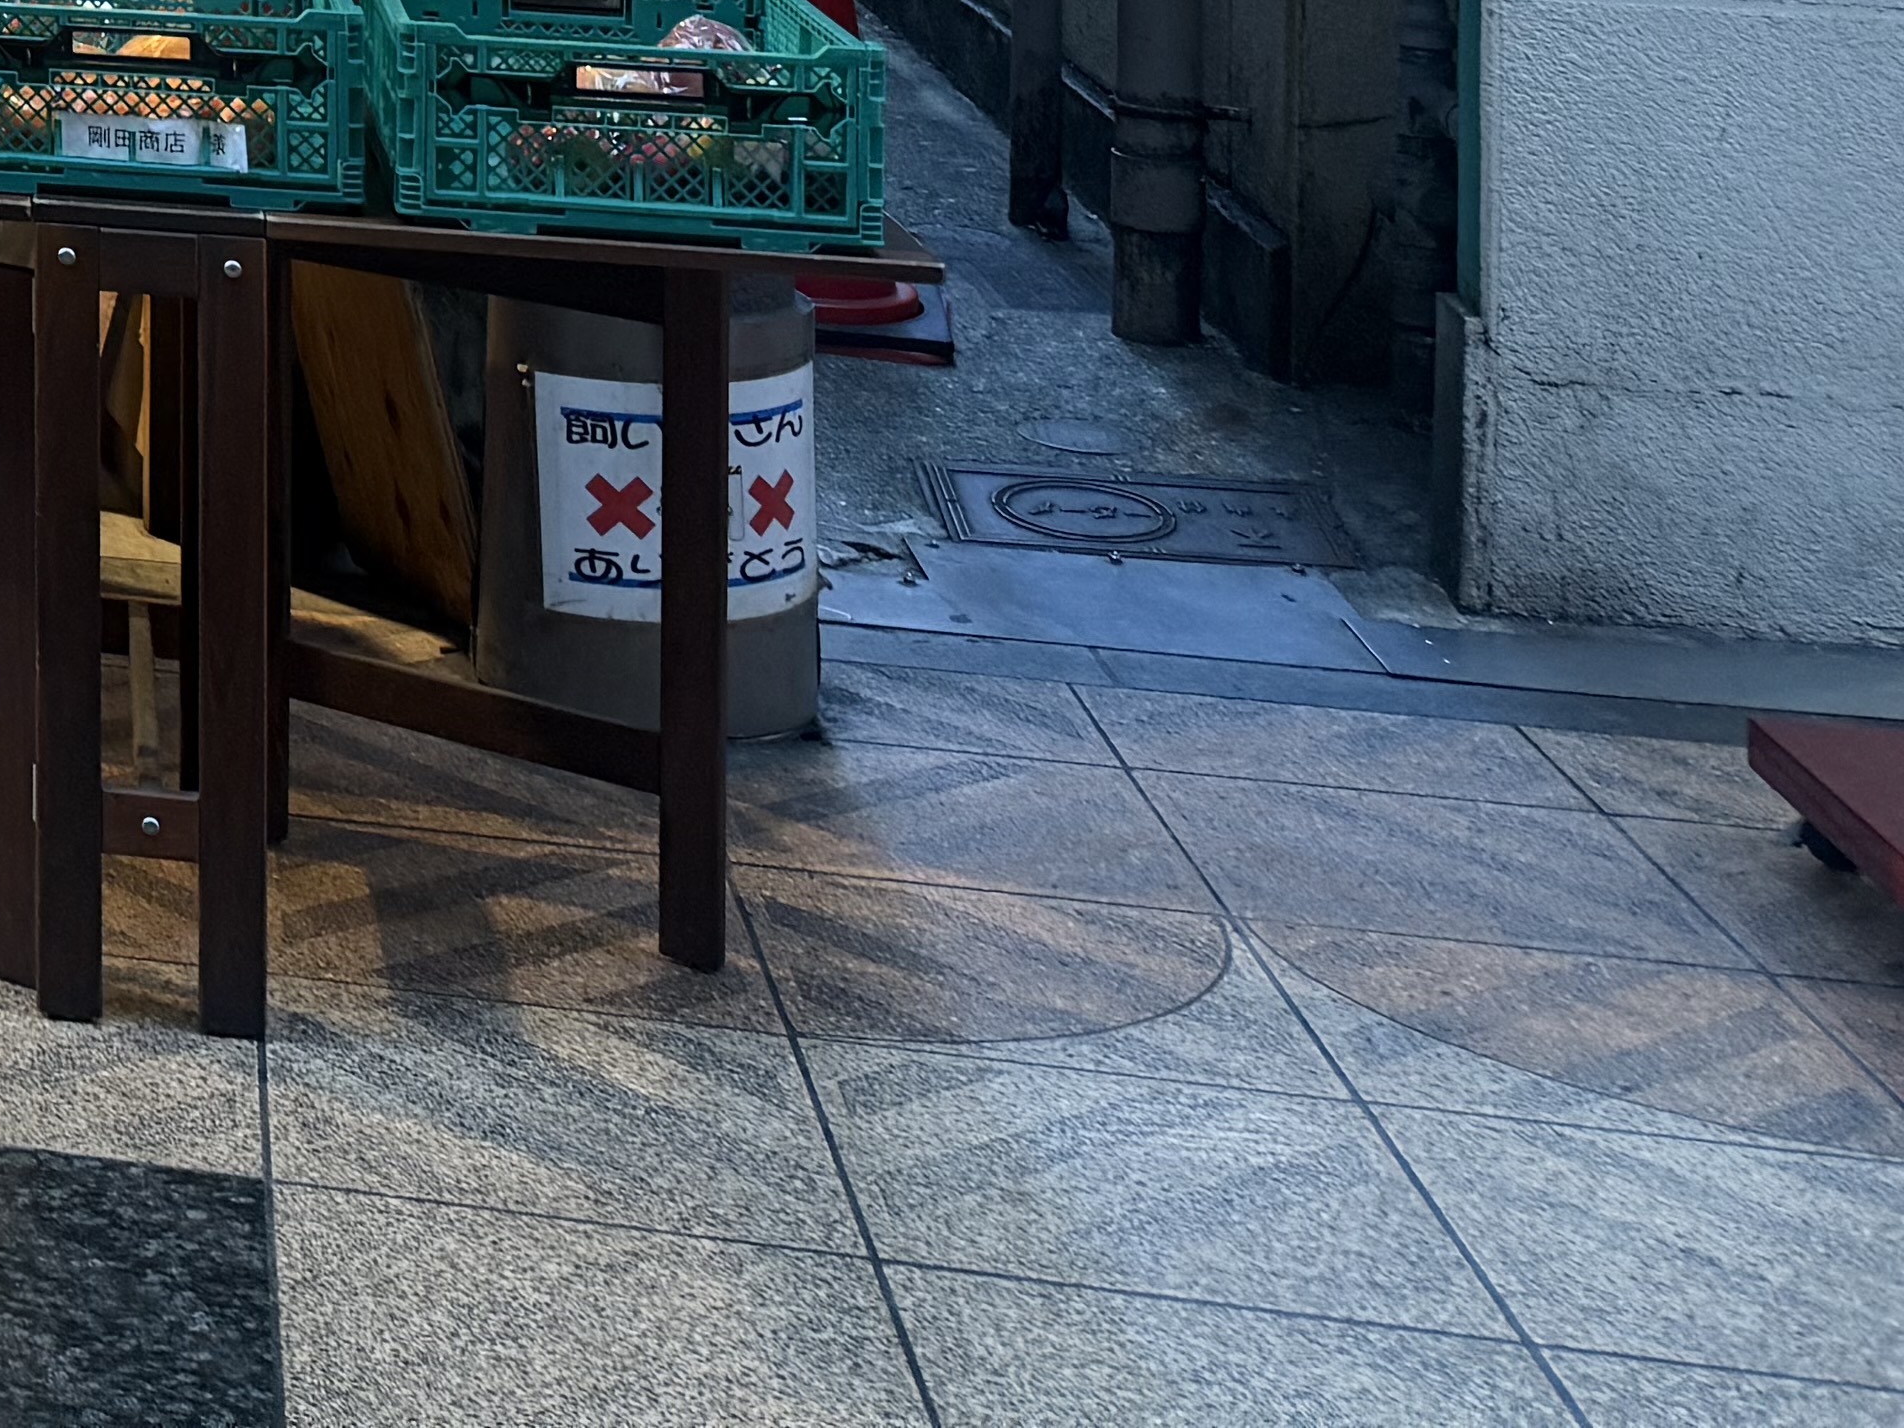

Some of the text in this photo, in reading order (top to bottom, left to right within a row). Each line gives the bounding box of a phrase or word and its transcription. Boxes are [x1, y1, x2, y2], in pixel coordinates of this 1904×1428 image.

[87, 125, 186, 154] 剛田商店
[564, 412, 805, 450] 飼いさん
[573, 538, 807, 582] あとう
